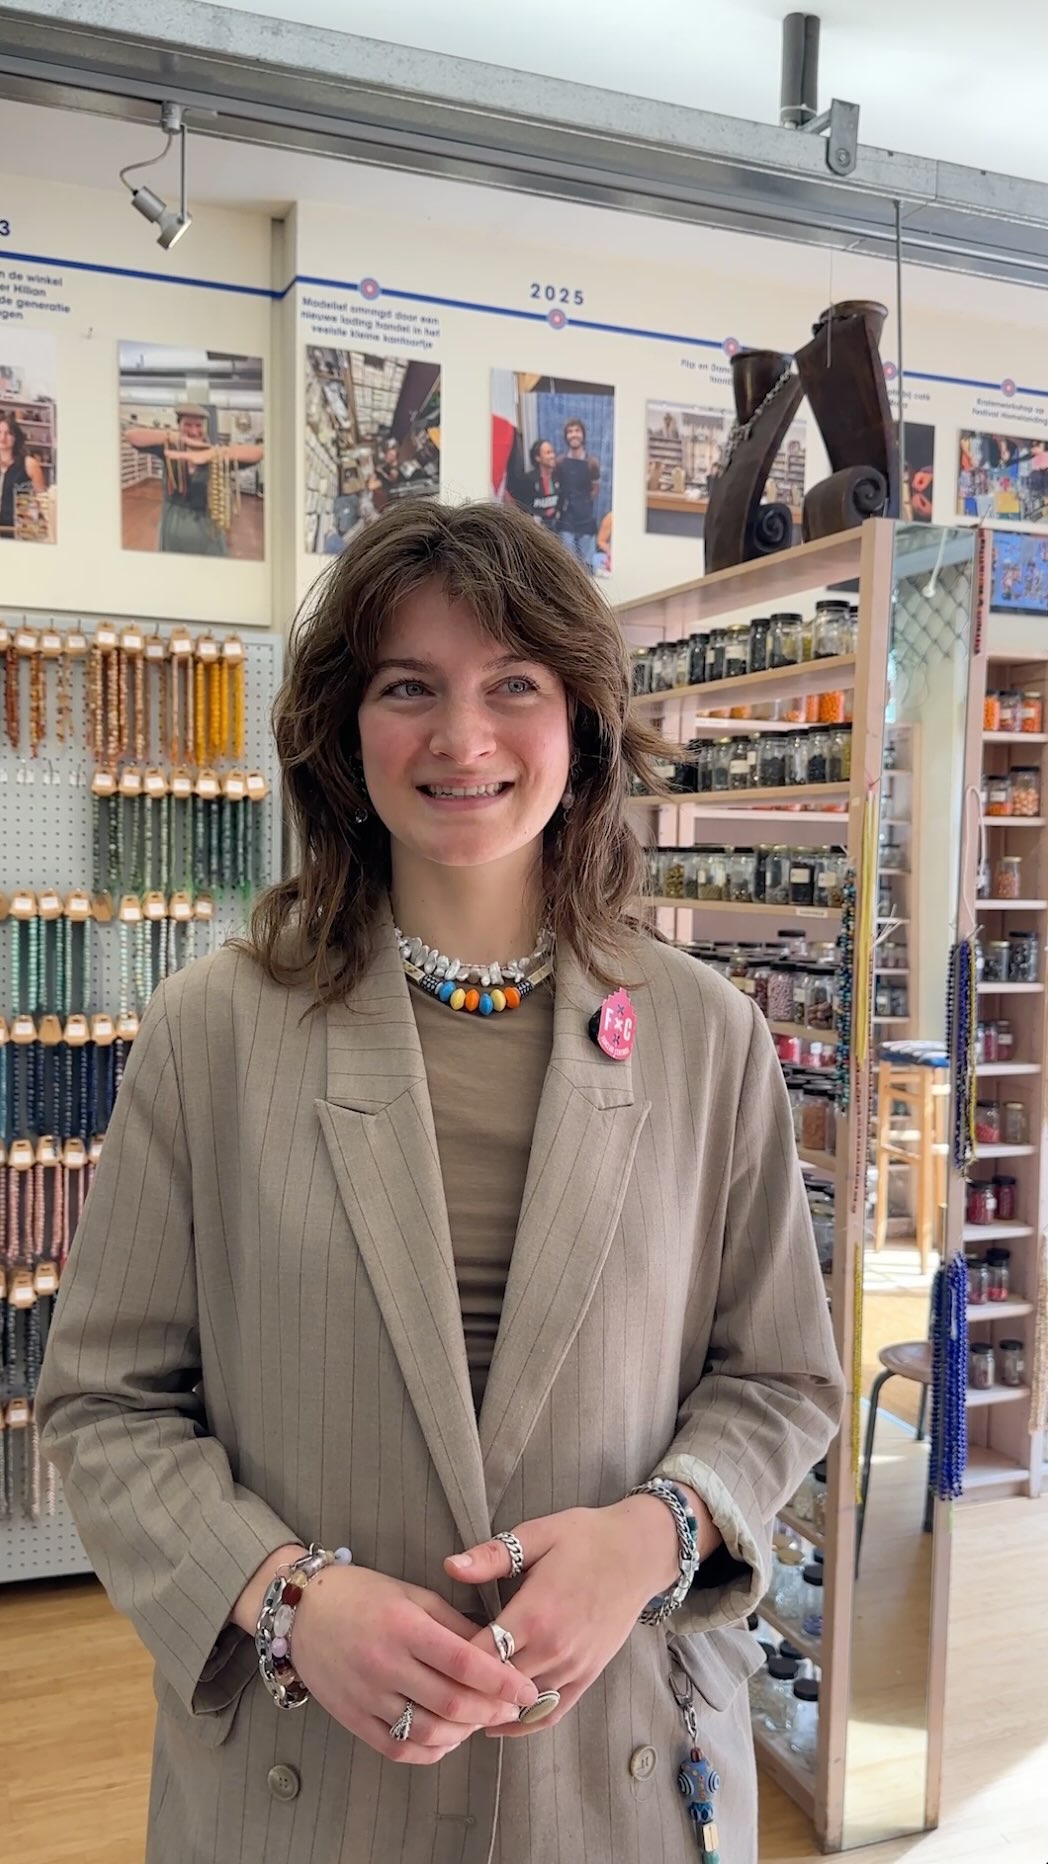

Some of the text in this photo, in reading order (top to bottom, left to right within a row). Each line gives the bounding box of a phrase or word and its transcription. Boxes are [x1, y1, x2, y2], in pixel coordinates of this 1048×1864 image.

[8, 271, 23, 281] de
[27, 274, 63, 287] winkel
[530, 283, 584, 306] 2025
[16, 299, 71, 313] generatie
[300, 311, 337, 322] nieuwe
[424, 327, 440, 337] het
[394, 311, 417, 322] door
[420, 316, 440, 325] een
[350, 329, 380, 341] kleine
[383, 334, 433, 350] kantoortje
